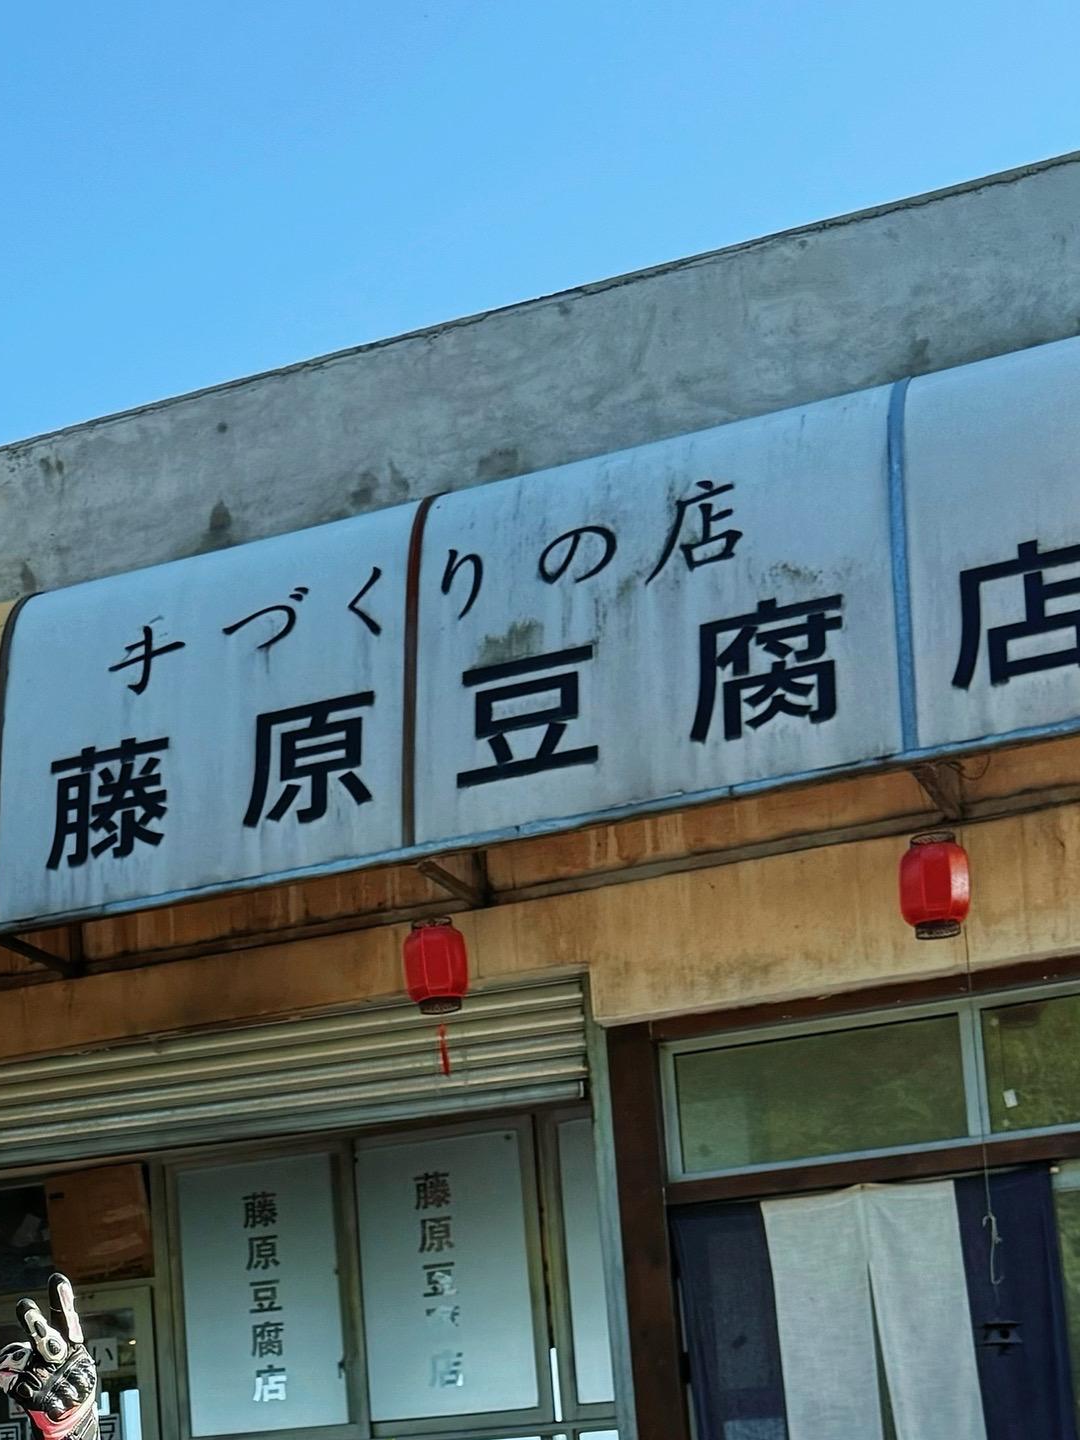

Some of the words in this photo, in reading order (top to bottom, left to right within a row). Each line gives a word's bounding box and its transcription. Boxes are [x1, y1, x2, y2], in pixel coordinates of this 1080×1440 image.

[241, 1191, 288, 1402] 藤原豆腐店
